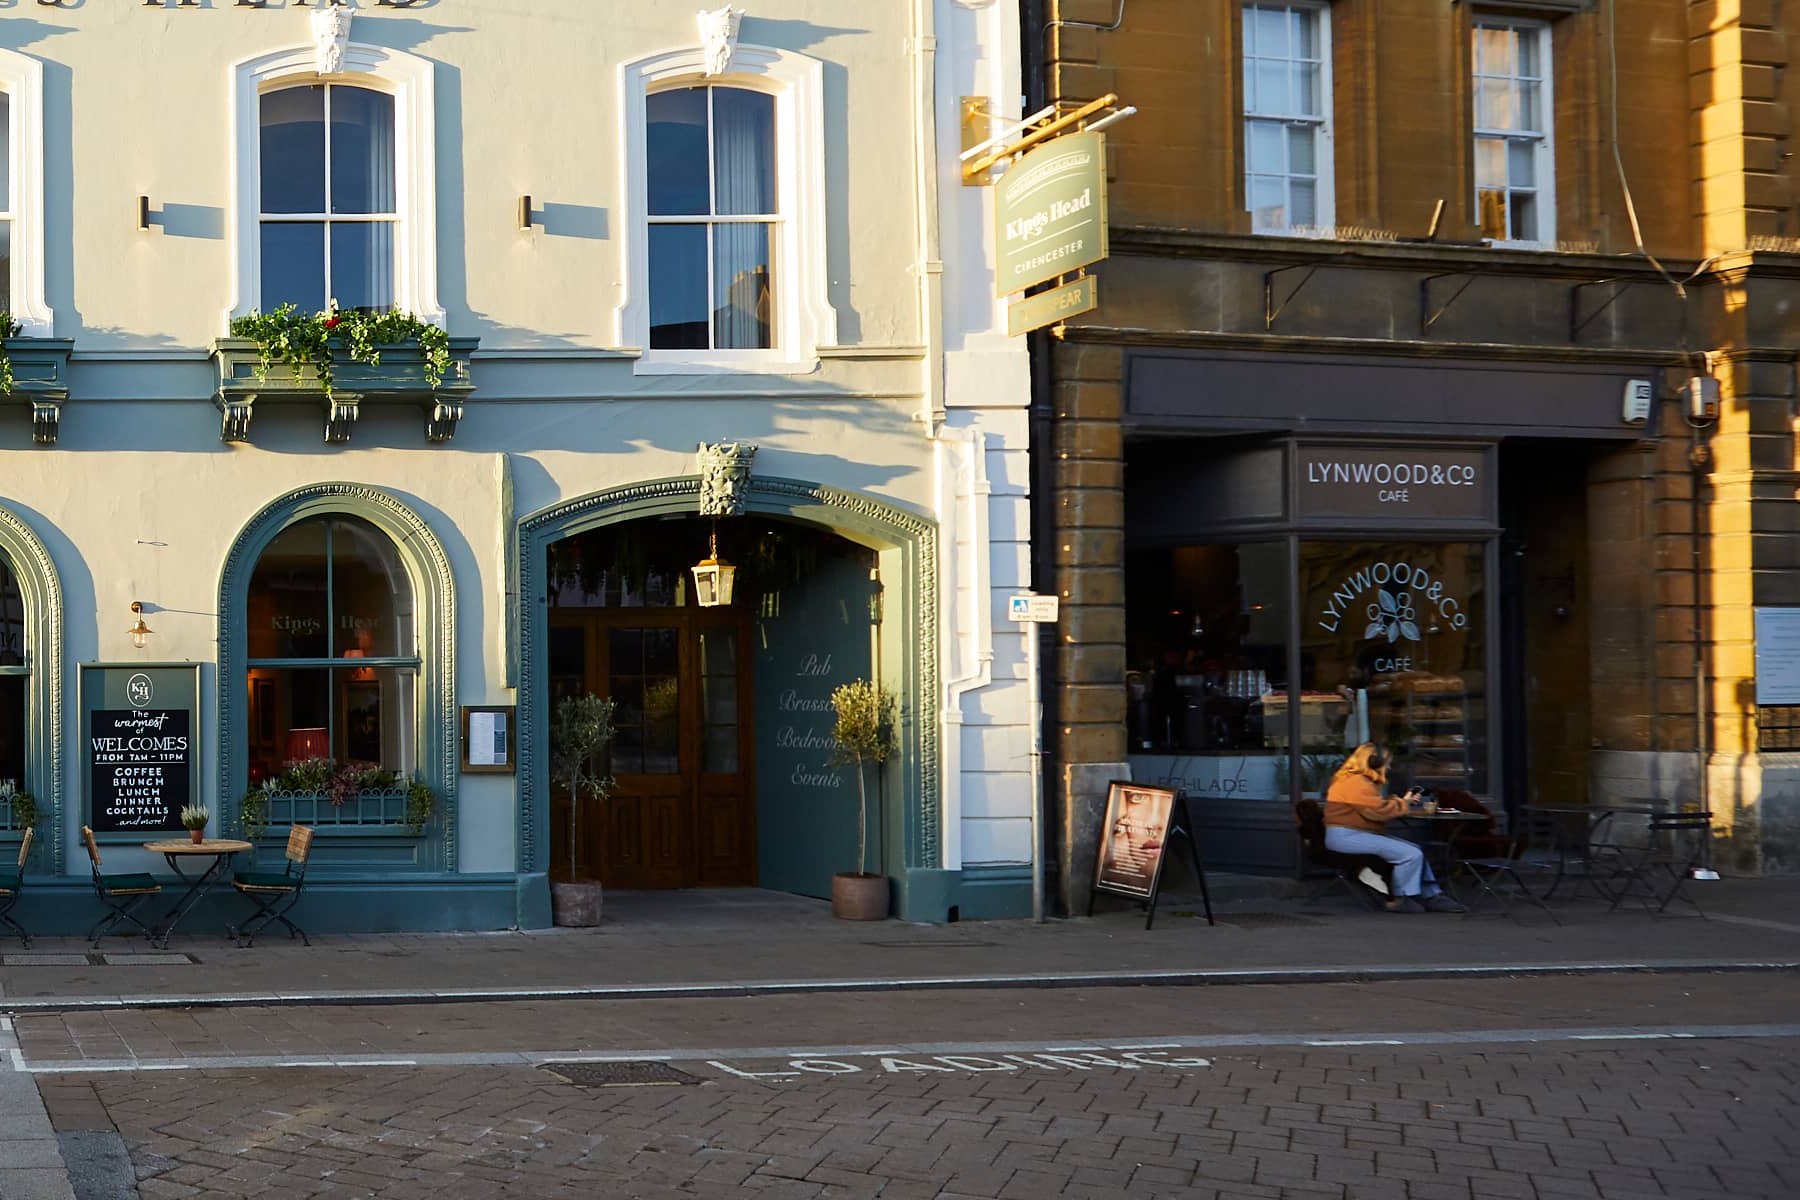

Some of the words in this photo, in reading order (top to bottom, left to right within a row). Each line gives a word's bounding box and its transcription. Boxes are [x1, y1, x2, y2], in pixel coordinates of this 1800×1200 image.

[1006, 211, 1049, 241] Kings
[1050, 187, 1091, 222] Head
[1015, 240, 1083, 274] CIRENCESTER
[1378, 488, 1409, 502] CAFÉ
[271, 615, 321, 635] Kings
[796, 654, 832, 676] Pub
[1375, 656, 1412, 672] CAFÉ
[780, 688, 838, 712] Brasse
[114, 712, 169, 731] warmest
[132, 710, 149, 718] The
[92, 736, 188, 752] WELCOMES
[777, 727, 843, 749] Bedroo
[96, 753, 124, 761] FROM
[129, 753, 148, 761] 7AM
[159, 753, 184, 761] 11PM
[114, 767, 162, 777] COFFEE
[792, 763, 841, 788] Events
[112, 778, 164, 787] BRUNCH
[118, 788, 160, 797] LUNCH
[115, 797, 162, 806] DINNER
[106, 806, 169, 815] COCKTAILS
[140, 815, 167, 825] more!
[707, 1052, 1217, 1079] LOADING
